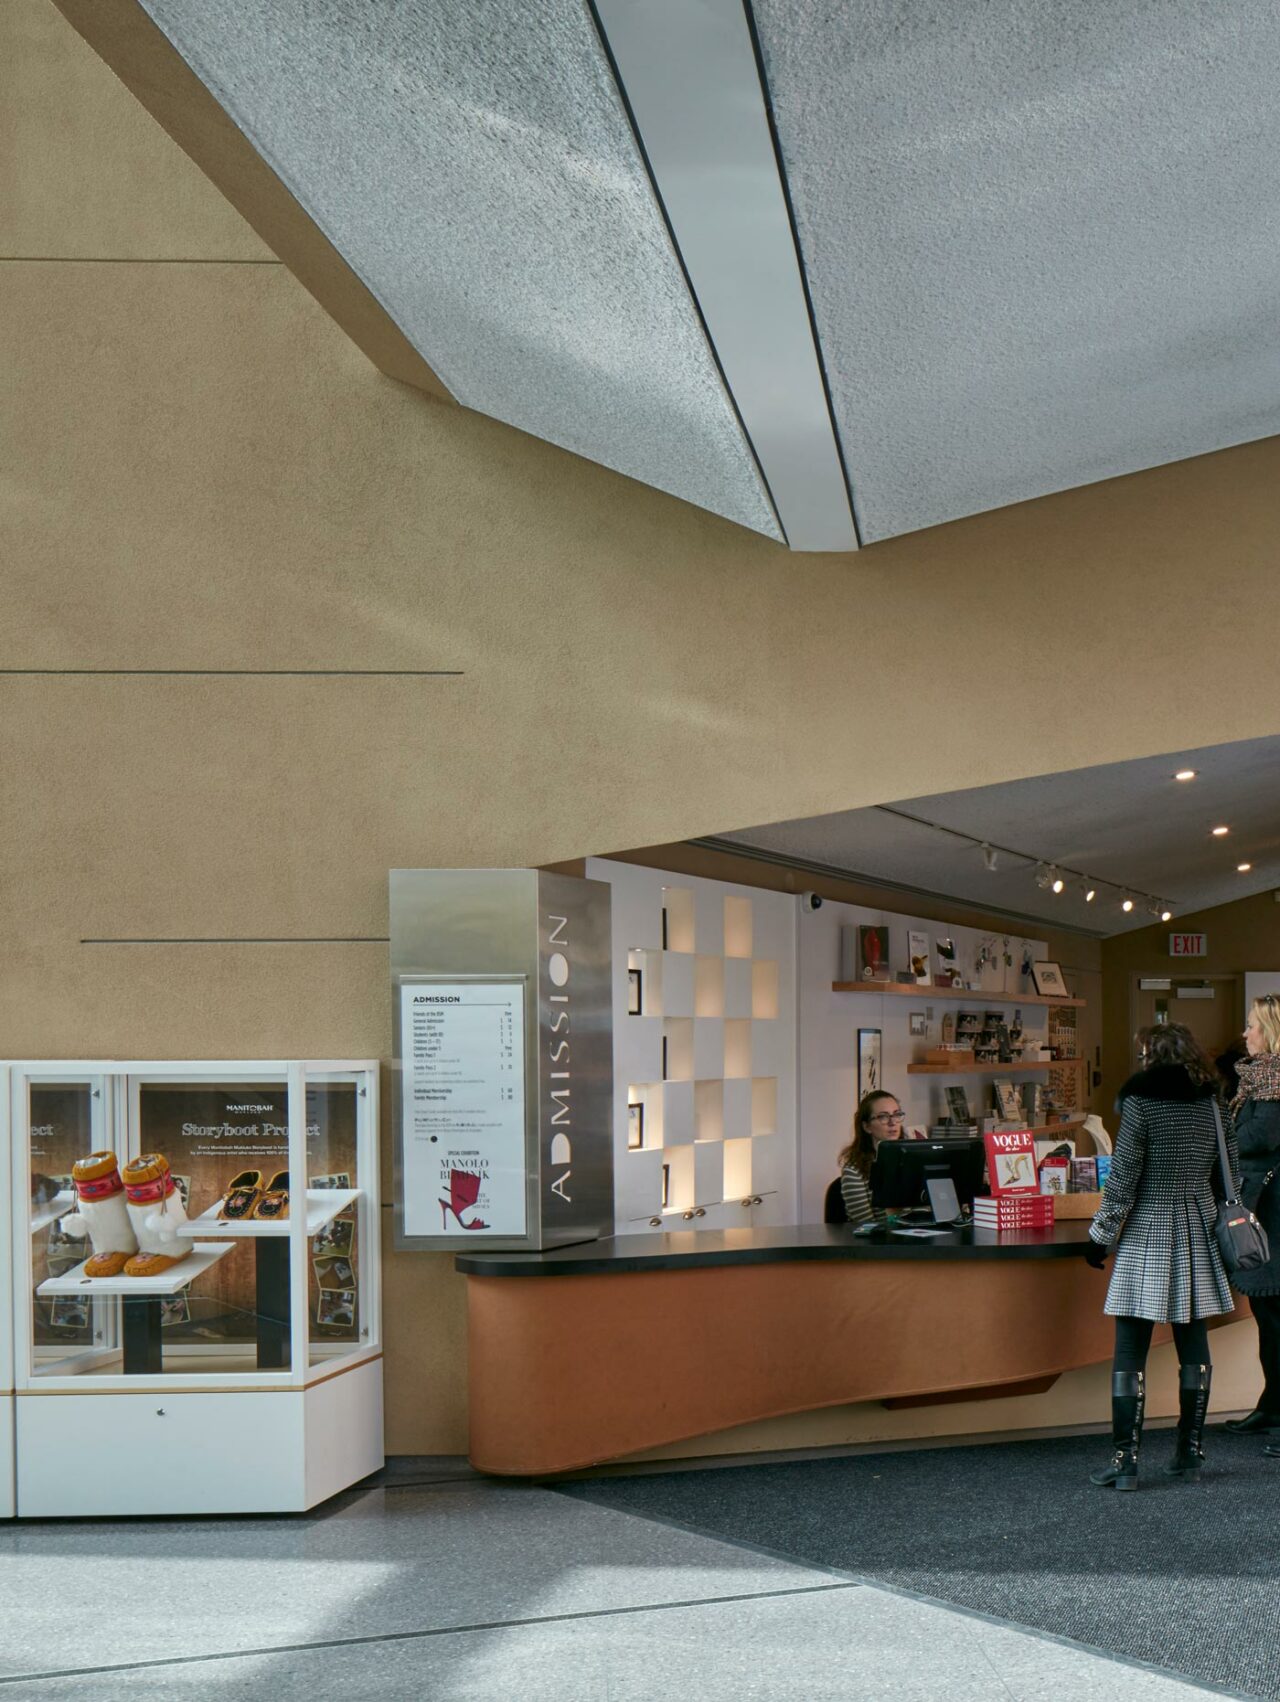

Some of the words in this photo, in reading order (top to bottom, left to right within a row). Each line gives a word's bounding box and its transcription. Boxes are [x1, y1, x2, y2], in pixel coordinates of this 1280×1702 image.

[1173, 935, 1202, 954] EXIT
[549, 915, 571, 1202] ADMISSION
[182, 1122, 259, 1138] Storyboot
[262, 1122, 320, 1138] Proct
[993, 1133, 1031, 1147] VOGUE
[440, 1159, 489, 1168] MANOLO
[1000, 1206, 1020, 1214] VOGUE
[1000, 1213, 1020, 1221] VOGUE
[1000, 1221, 1020, 1229] VOGUE
